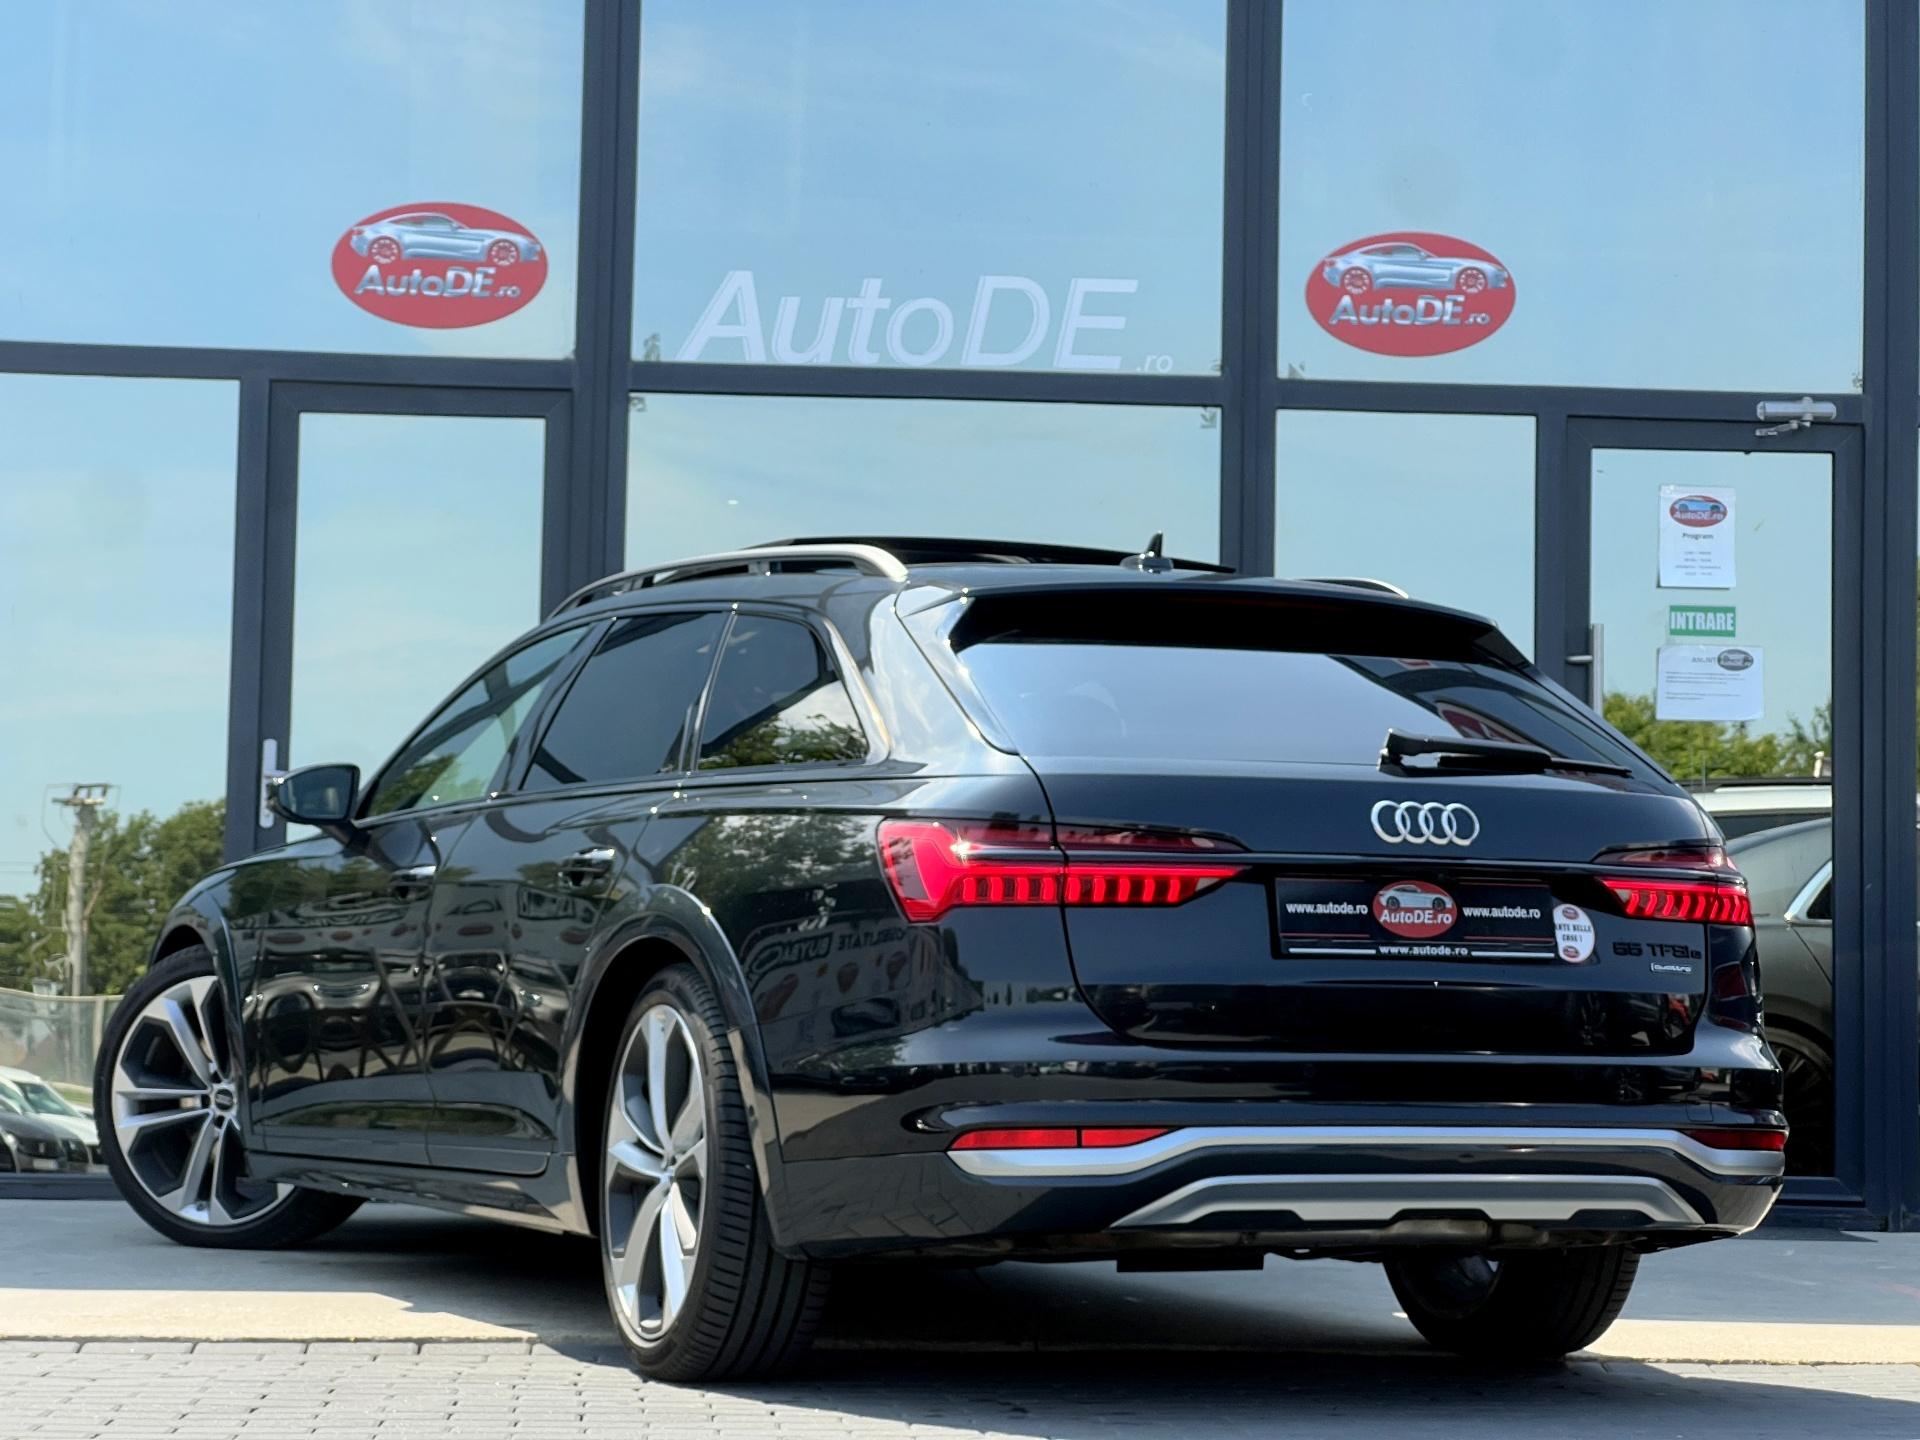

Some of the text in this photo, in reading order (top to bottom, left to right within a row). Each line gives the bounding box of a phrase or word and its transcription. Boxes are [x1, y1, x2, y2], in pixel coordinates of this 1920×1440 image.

[1670, 611, 1735, 631] INTRARE
[1285, 901, 1369, 915] www.autode.ro
[1462, 905, 1541, 919] www.autode.ro
[1379, 909, 1453, 924] AutoDE.ro
[1378, 944, 1469, 957] www.autode.ro
